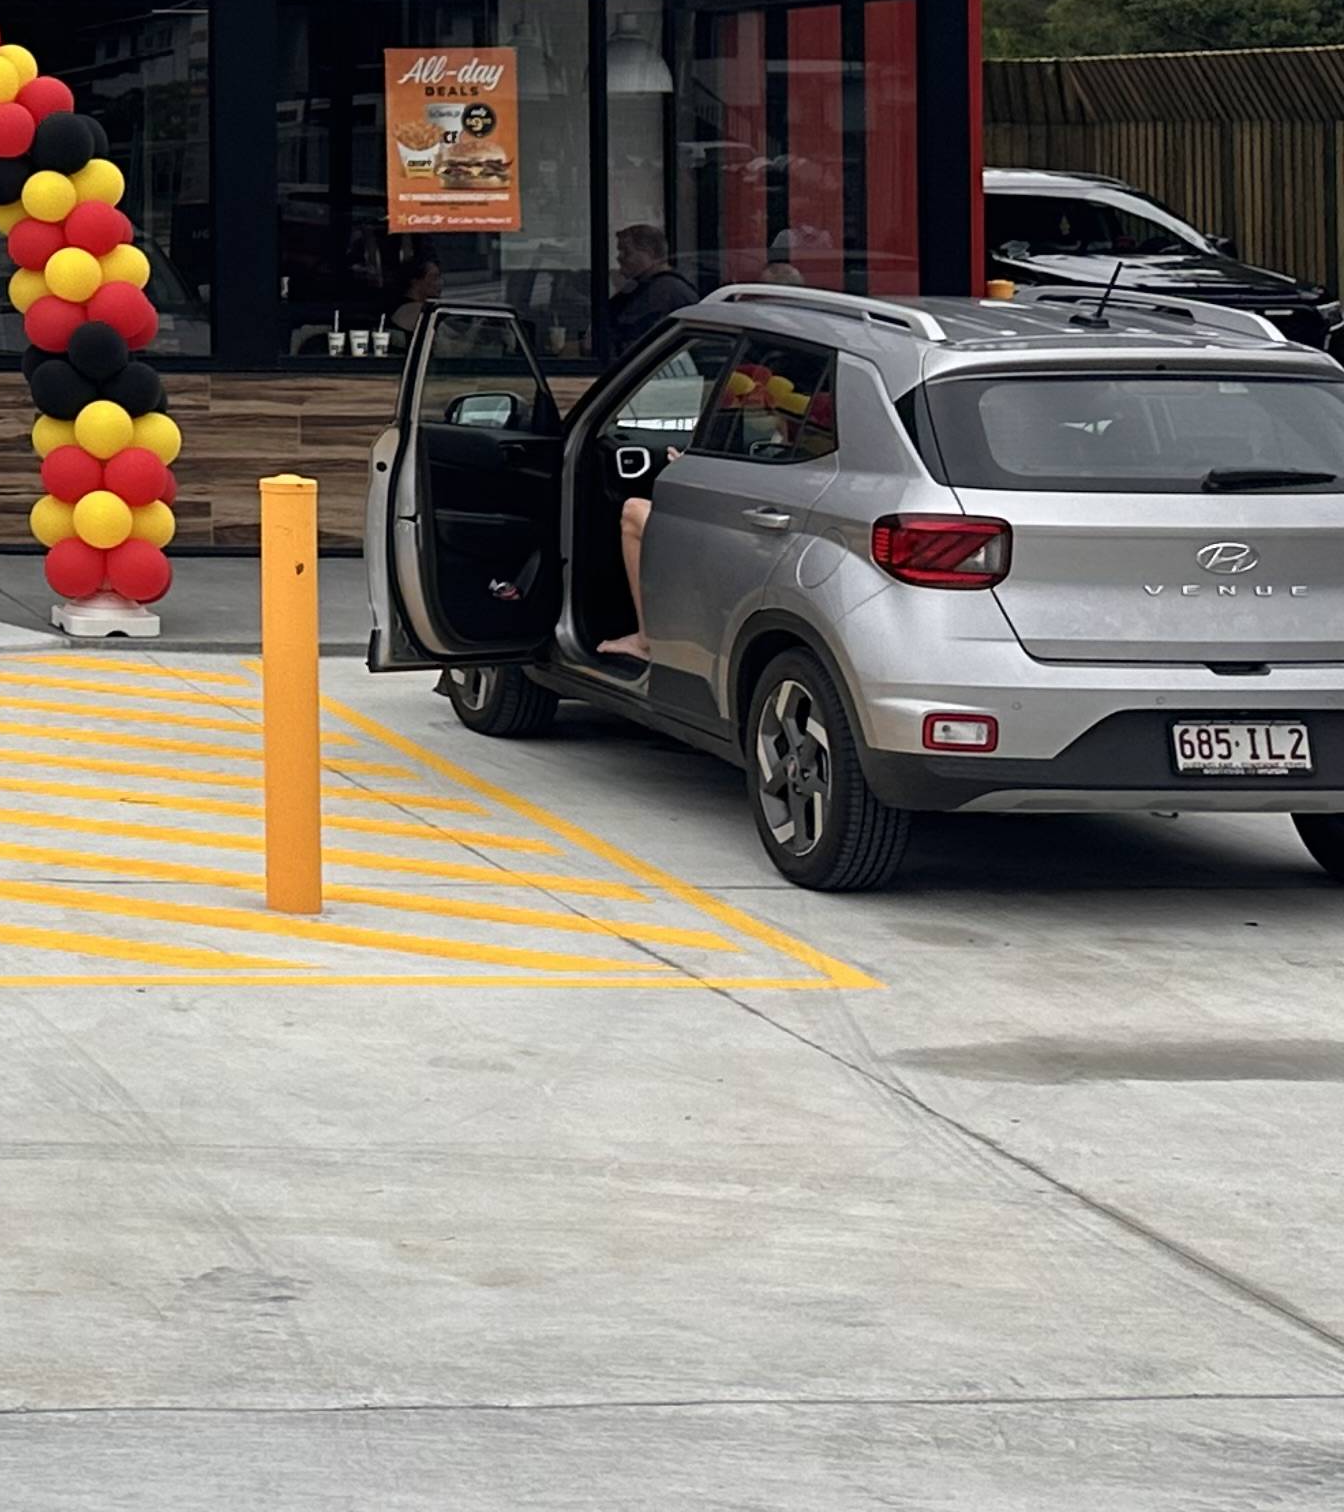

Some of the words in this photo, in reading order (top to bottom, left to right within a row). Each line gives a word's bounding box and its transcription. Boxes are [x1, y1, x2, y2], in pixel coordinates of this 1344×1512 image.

[397, 55, 505, 91] All-day
[424, 86, 480, 97] DEALS
[1144, 584, 1308, 597] VENUE
